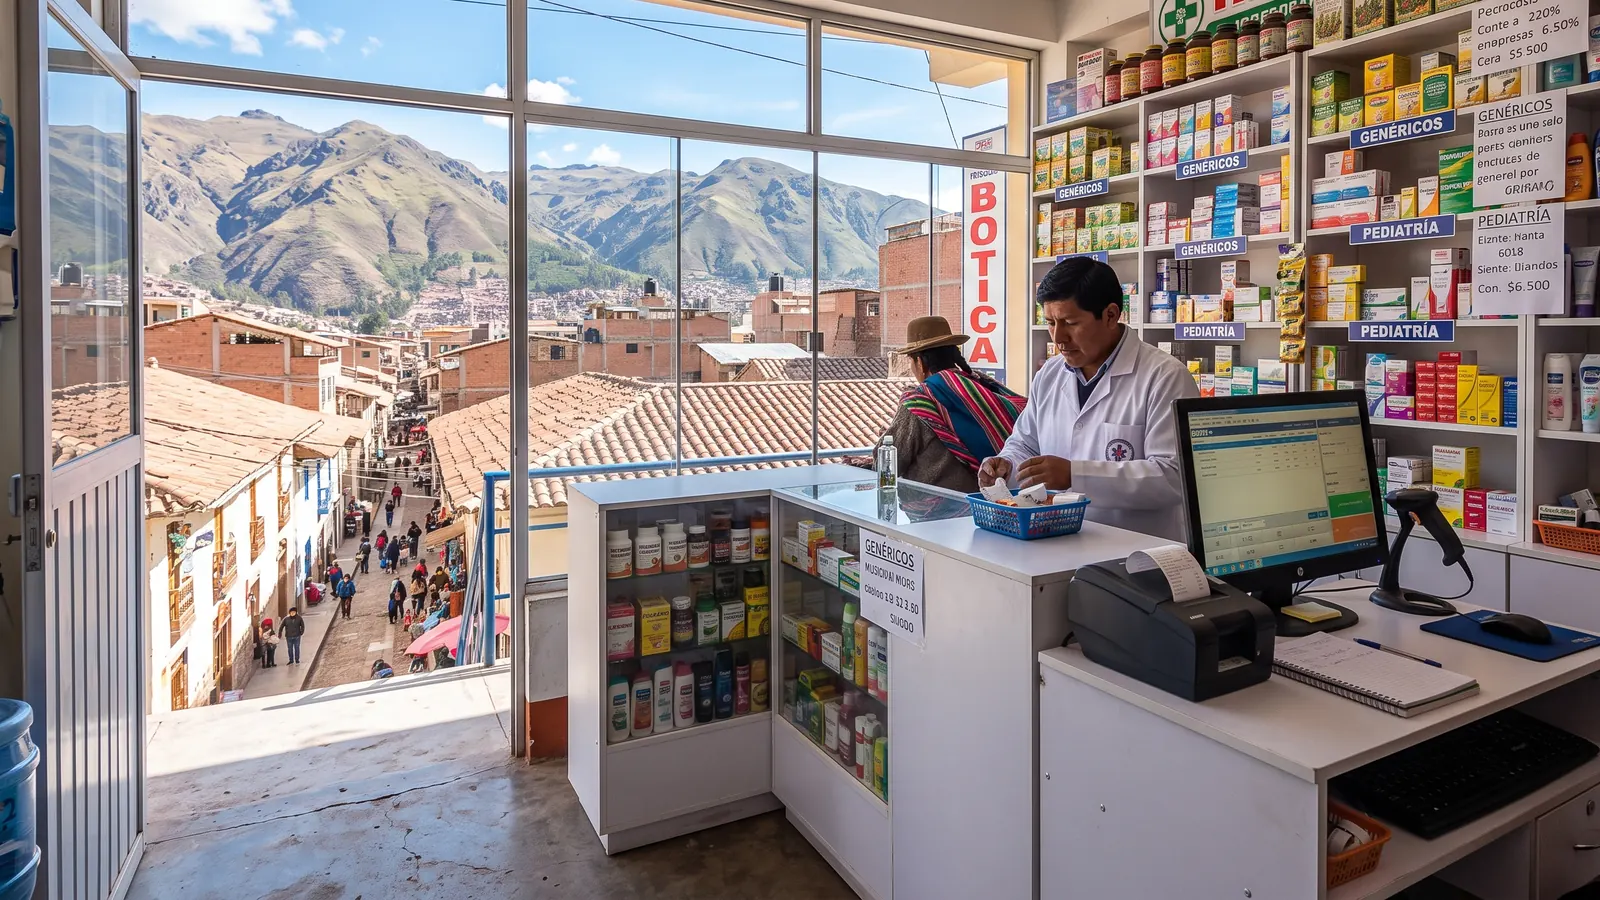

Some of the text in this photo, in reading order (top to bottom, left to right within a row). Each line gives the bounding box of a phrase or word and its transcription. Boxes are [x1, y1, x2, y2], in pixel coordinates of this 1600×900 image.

[1478, 4, 1560, 35] Conte a 220%
[1542, 17, 1579, 34] 6.50%
[1478, 55, 1500, 67] Cera
[1479, 98, 1553, 122] GENÉRICOS
[1360, 117, 1442, 144] GENÉRICOS
[1526, 151, 1540, 161] de
[1183, 155, 1240, 176] GENÉRICOS
[1520, 169, 1539, 179] por
[1060, 182, 1102, 199] GENÉRICOS
[1479, 206, 1551, 227] PEDIATRÍA
[1363, 220, 1439, 239] PEDIATRÍA
[1182, 240, 1238, 256] GENÉRICOS
[1498, 247, 1524, 257] 6018
[969, 182, 998, 364] BOTICA
[1478, 264, 1511, 274] Siente:
[1478, 280, 1550, 293] Con. $6.500
[1183, 324, 1235, 337] PEDIATRÍA
[1361, 322, 1439, 338] PEDIATRÍA
[865, 539, 914, 568] GENÉRICOS
